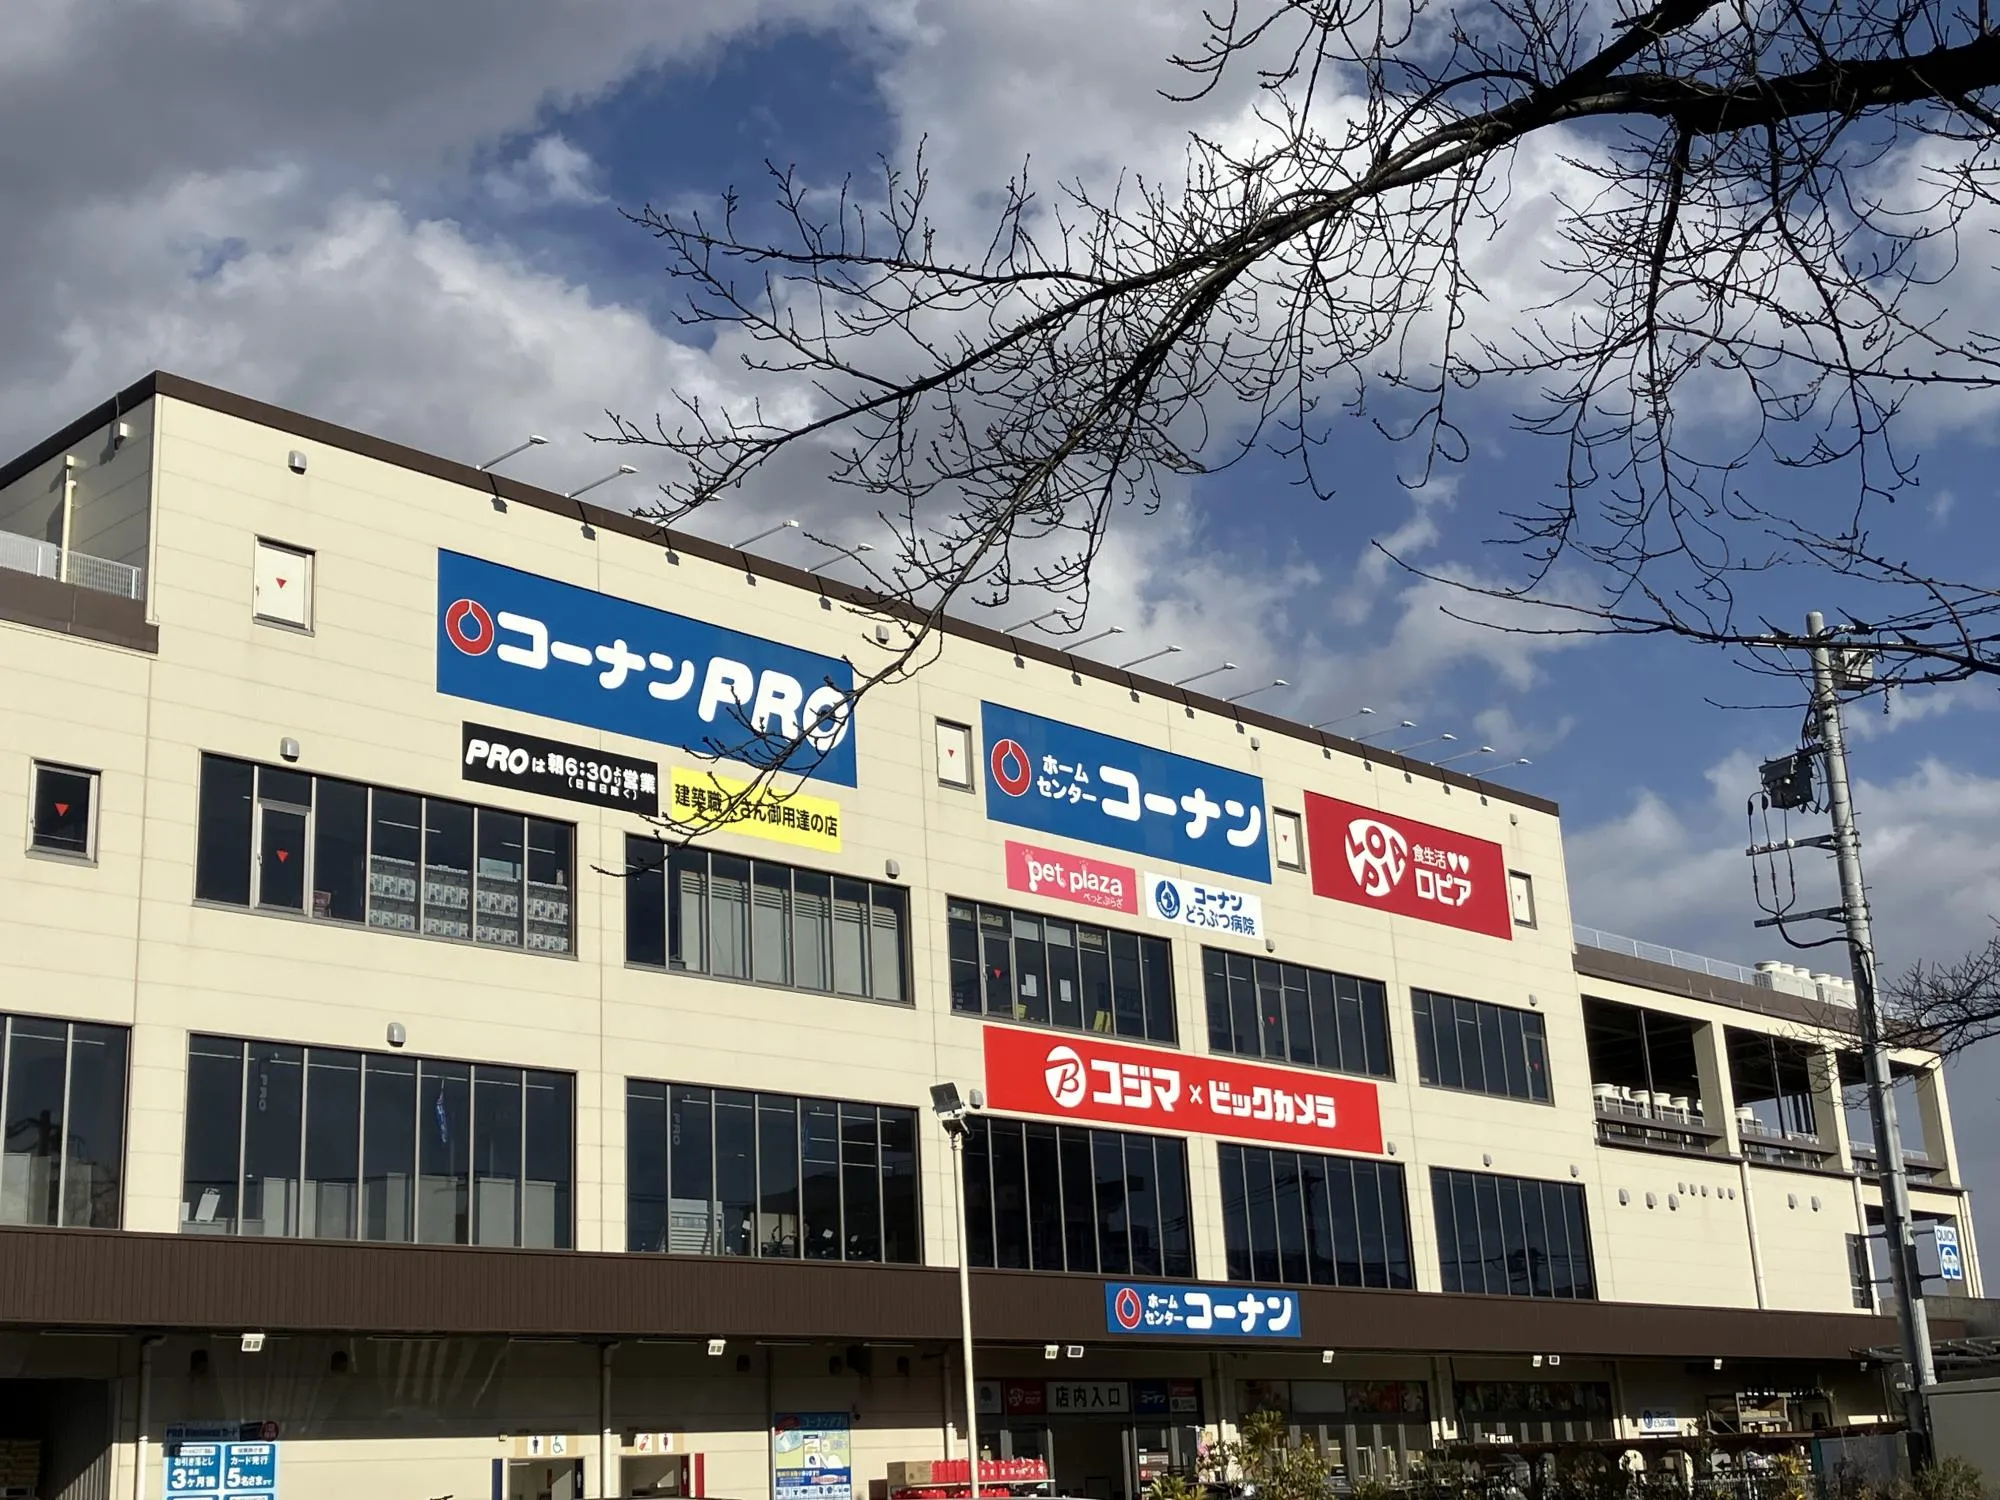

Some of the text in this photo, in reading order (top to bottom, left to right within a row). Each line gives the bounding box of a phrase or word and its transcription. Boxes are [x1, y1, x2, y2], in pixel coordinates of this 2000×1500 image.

[1042, 755, 1089, 784] ホーム
[1036, 776, 1097, 805] センター
[1099, 765, 1262, 848] コーナン
[1412, 843, 1447, 870] 食生活
[1028, 859, 1123, 897] pet plaza
[1415, 867, 1472, 907] ロピア
[1194, 887, 1242, 911] コーナン
[1186, 904, 1255, 935] どうぶつ病院
[1147, 1293, 1179, 1310] ホーム
[1184, 1292, 1292, 1333] コーナン
[1144, 1310, 1184, 1327] センター
[1055, 1385, 1120, 1407] 店内入口
